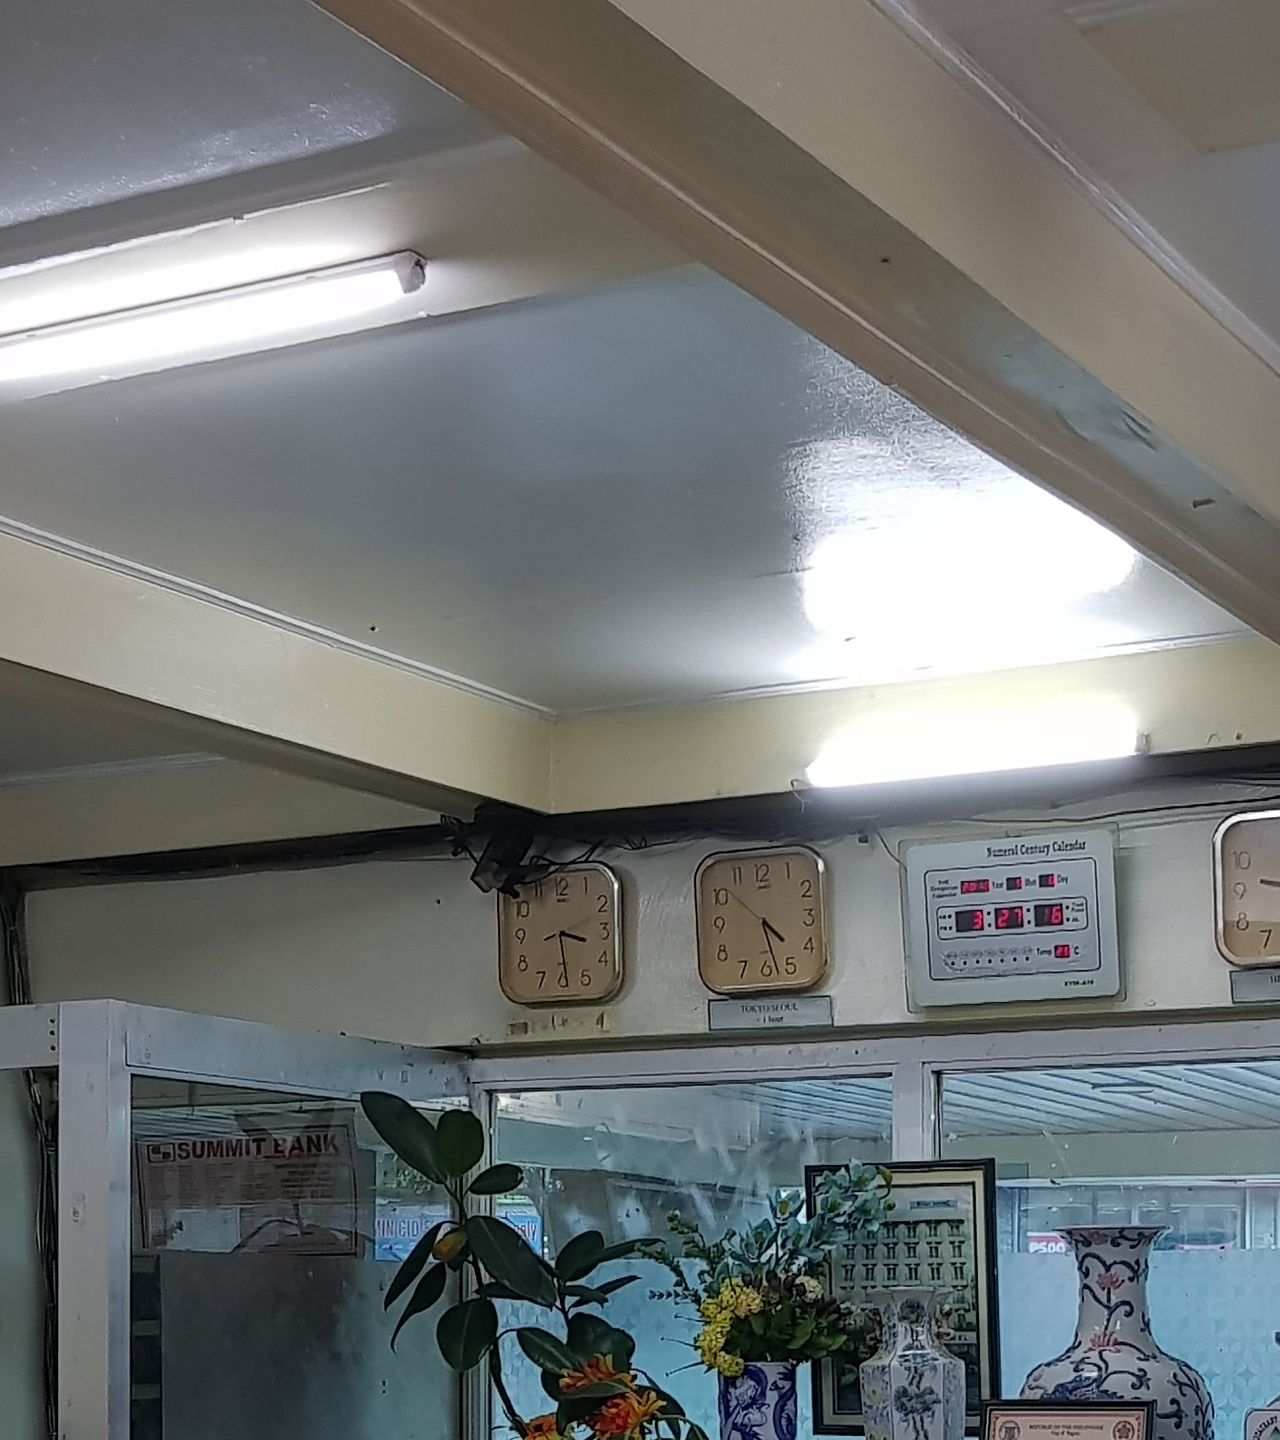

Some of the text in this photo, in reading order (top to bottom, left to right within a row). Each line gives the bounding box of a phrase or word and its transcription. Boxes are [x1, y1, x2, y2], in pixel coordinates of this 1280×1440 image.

[1052, 840, 1086, 851] Calendar
[1232, 851, 1251, 870] 10
[733, 867, 742, 884] 11
[754, 864, 770, 882] 12
[786, 862, 790, 879] 1
[555, 878, 569, 896] 12
[800, 880, 812, 898] 2
[1234, 883, 1246, 900] 9
[597, 895, 608, 912] 2
[713, 888, 728, 906] 10
[516, 901, 530, 918] 10
[803, 908, 815, 927] 3
[714, 916, 725, 934] 9
[973, 911, 983, 929] 3
[1236, 912, 1249, 931] 8
[515, 928, 526, 944] 9
[600, 922, 609, 940] 3
[1260, 929, 1272, 948] 7
[717, 944, 728, 962] 8
[803, 937, 815, 954] 4
[517, 955, 528, 972] 8
[598, 951, 609, 966] 4
[785, 957, 797, 975] 5
[580, 969, 592, 986] 5
[738, 960, 748, 979] 7
[760, 960, 772, 977] 6
[536, 971, 546, 989] 7
[177, 1133, 340, 1160] SUMMIT BANK
